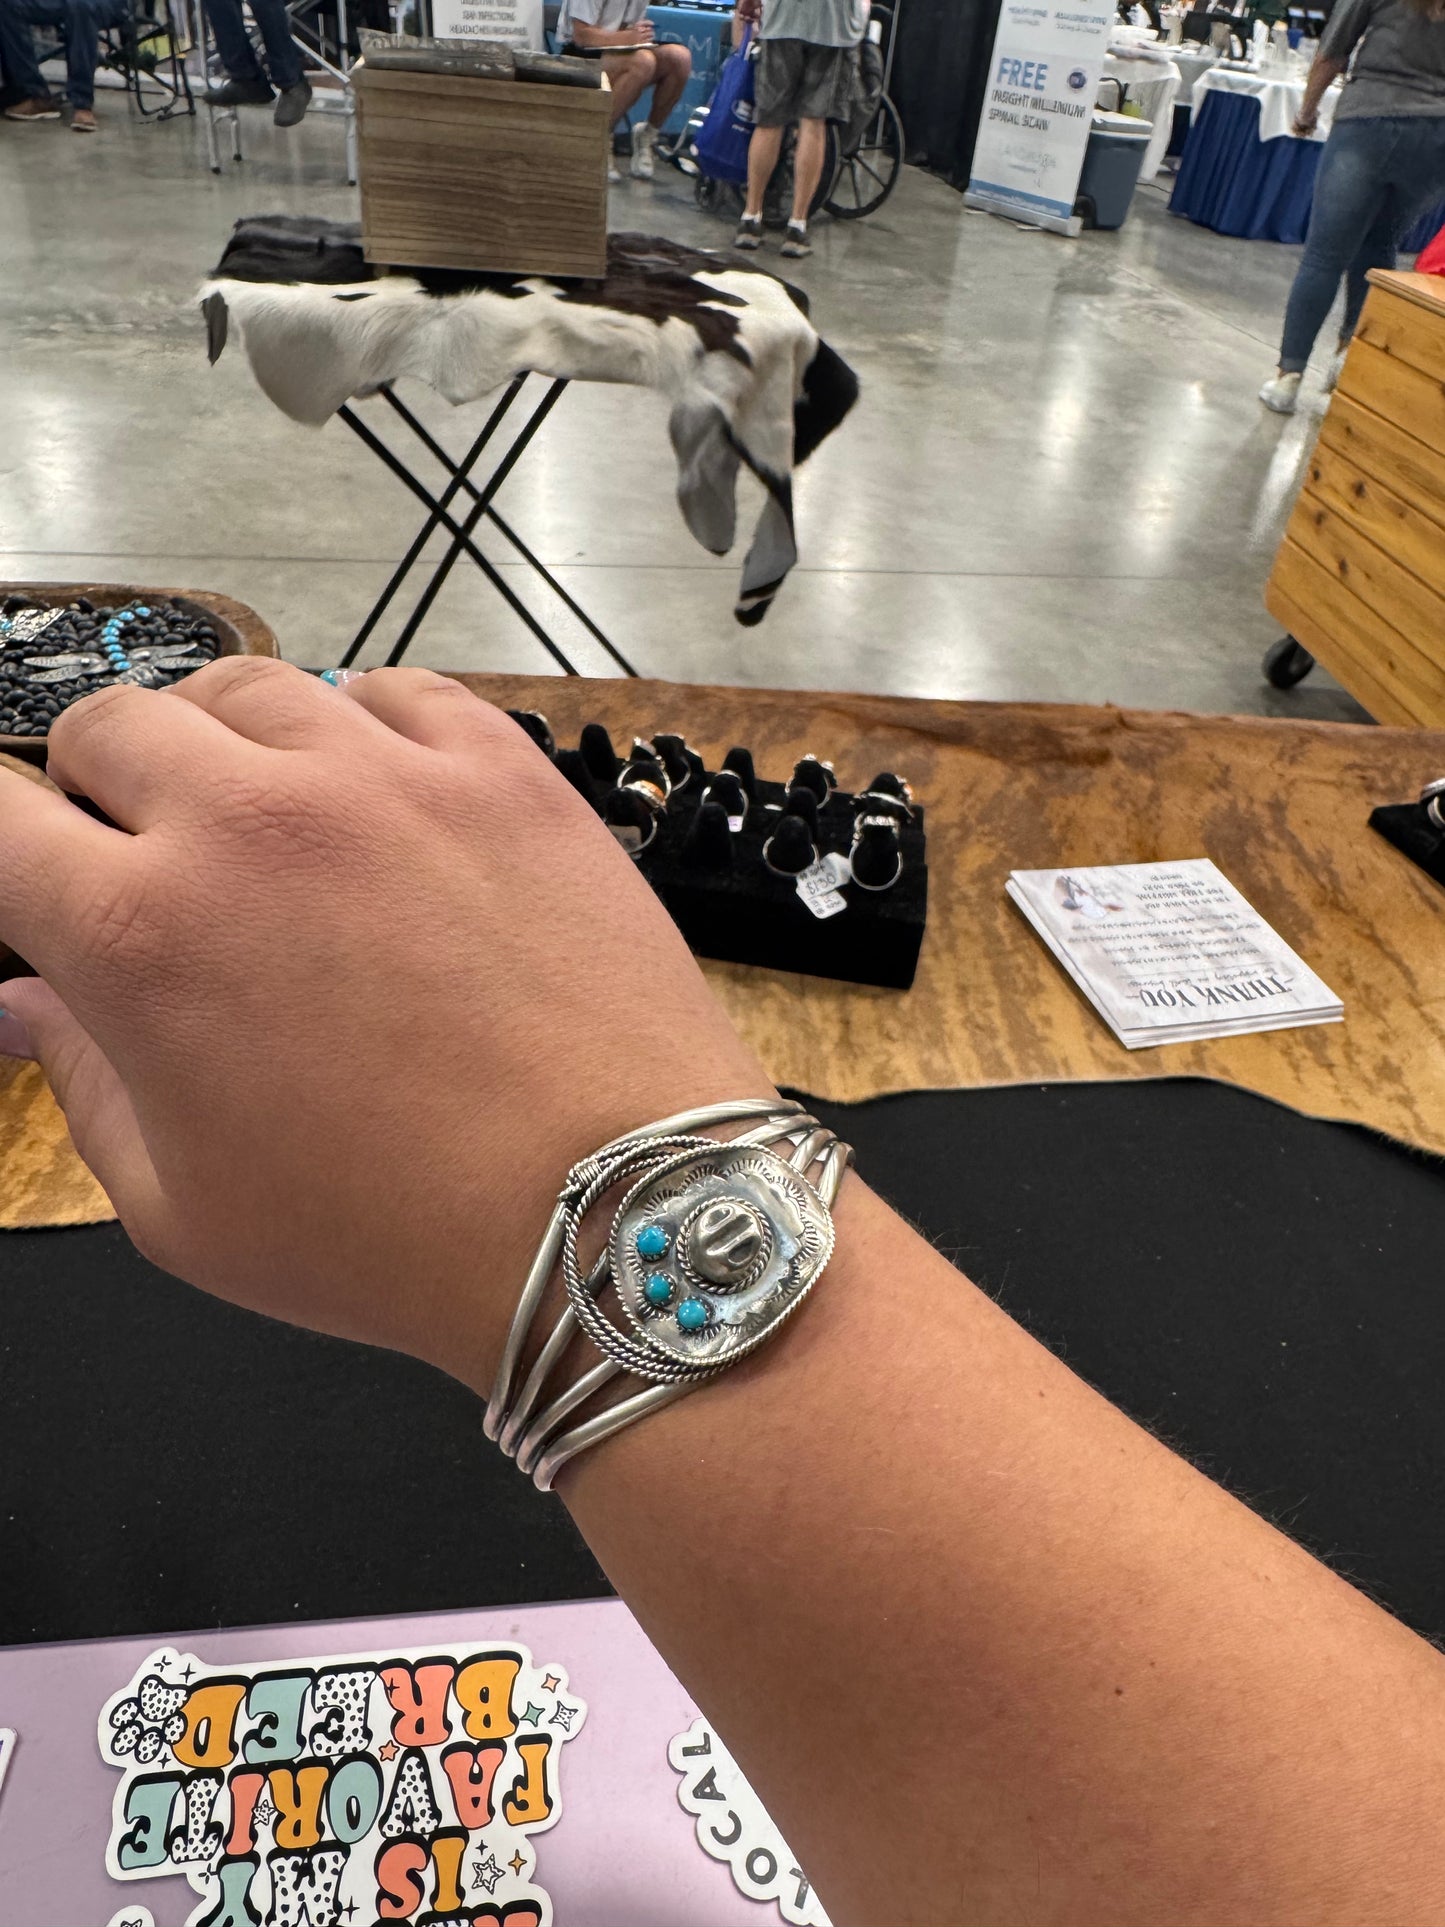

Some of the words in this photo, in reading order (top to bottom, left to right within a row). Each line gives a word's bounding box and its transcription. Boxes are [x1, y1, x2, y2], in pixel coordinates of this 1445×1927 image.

[997, 57, 1048, 91] FREE
[1139, 988, 1197, 1008] YOU
[1192, 975, 1292, 1006] THANK
[170, 1651, 522, 1768] BREED
[118, 1733, 552, 1869] FAVORITE
[682, 1732, 809, 1910] LOCAL
[198, 1842, 352, 1927] MY
[374, 1826, 470, 1918] IS
